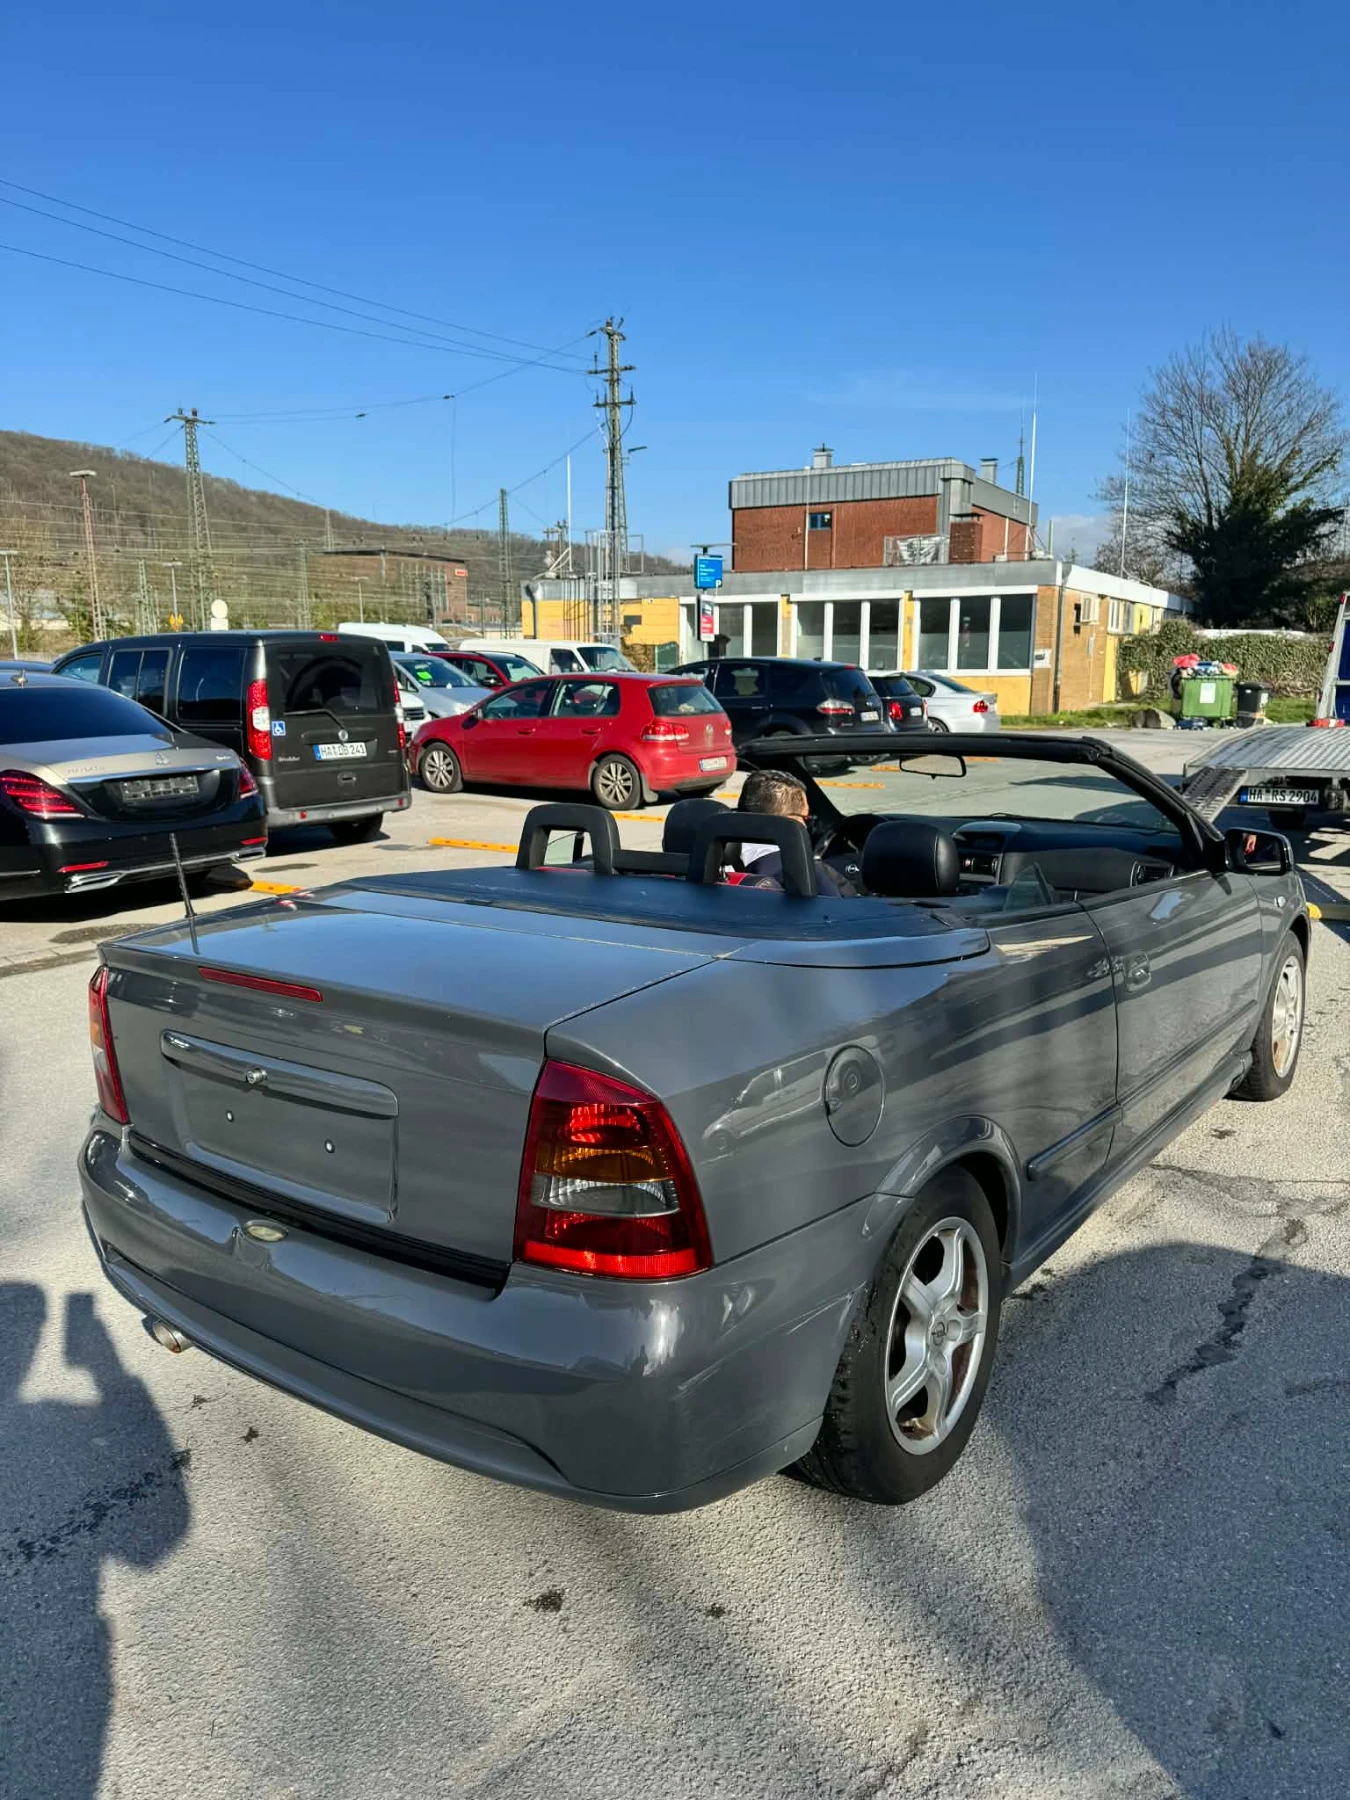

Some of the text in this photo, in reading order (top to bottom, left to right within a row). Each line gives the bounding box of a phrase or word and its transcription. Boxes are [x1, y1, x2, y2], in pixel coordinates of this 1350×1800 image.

[320, 746, 333, 756] HA
[350, 744, 366, 754] 241
[1249, 788, 1317, 803] HA RS 2904
